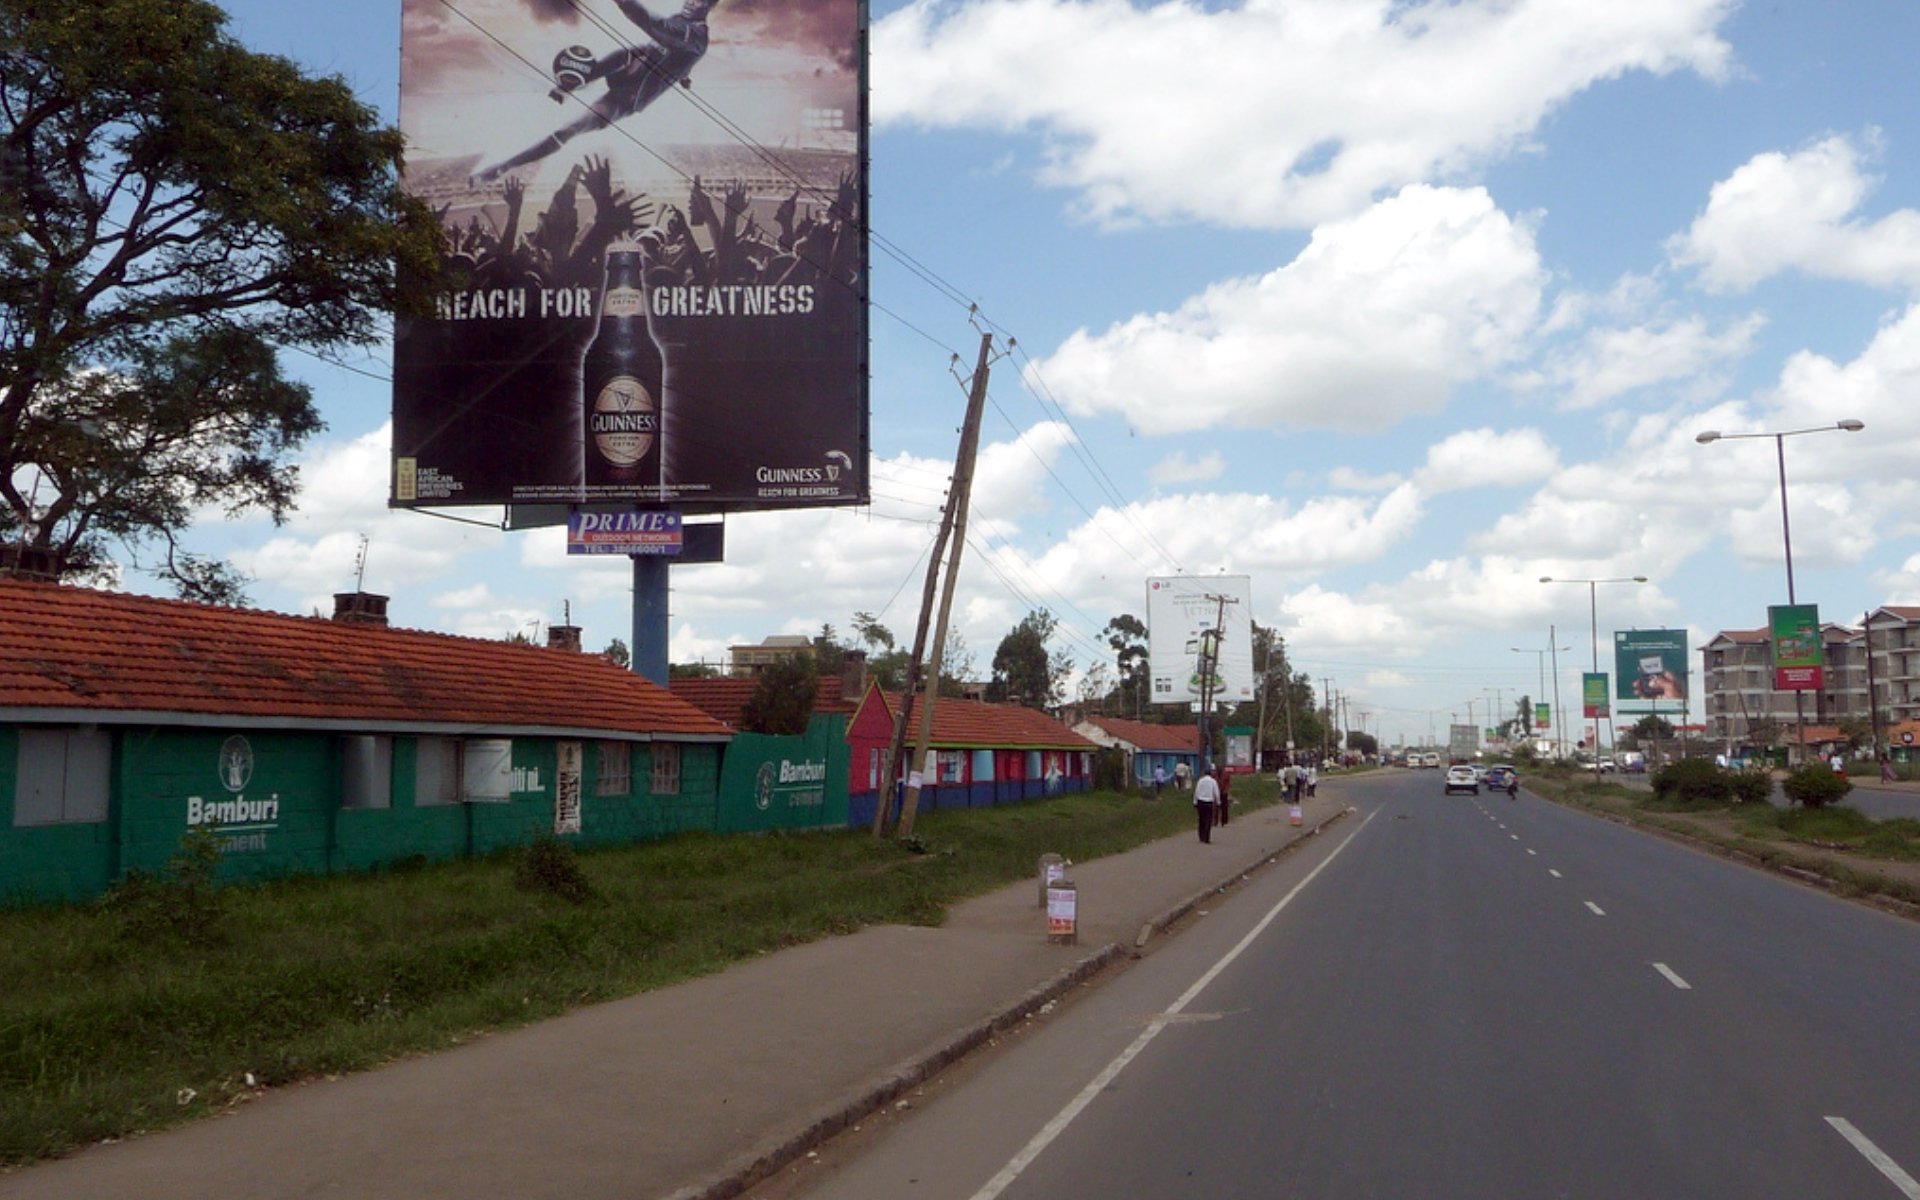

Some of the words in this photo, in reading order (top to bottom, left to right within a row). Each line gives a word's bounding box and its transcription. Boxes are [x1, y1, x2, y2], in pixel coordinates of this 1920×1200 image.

[541, 287, 592, 318] FOR
[652, 284, 815, 317] GREATNESS
[590, 412, 657, 433] GUINNESS
[756, 465, 823, 483] GUINNESS
[576, 513, 666, 541] PRIME
[779, 757, 826, 784] Bamburi
[187, 793, 278, 825] Bamburi
